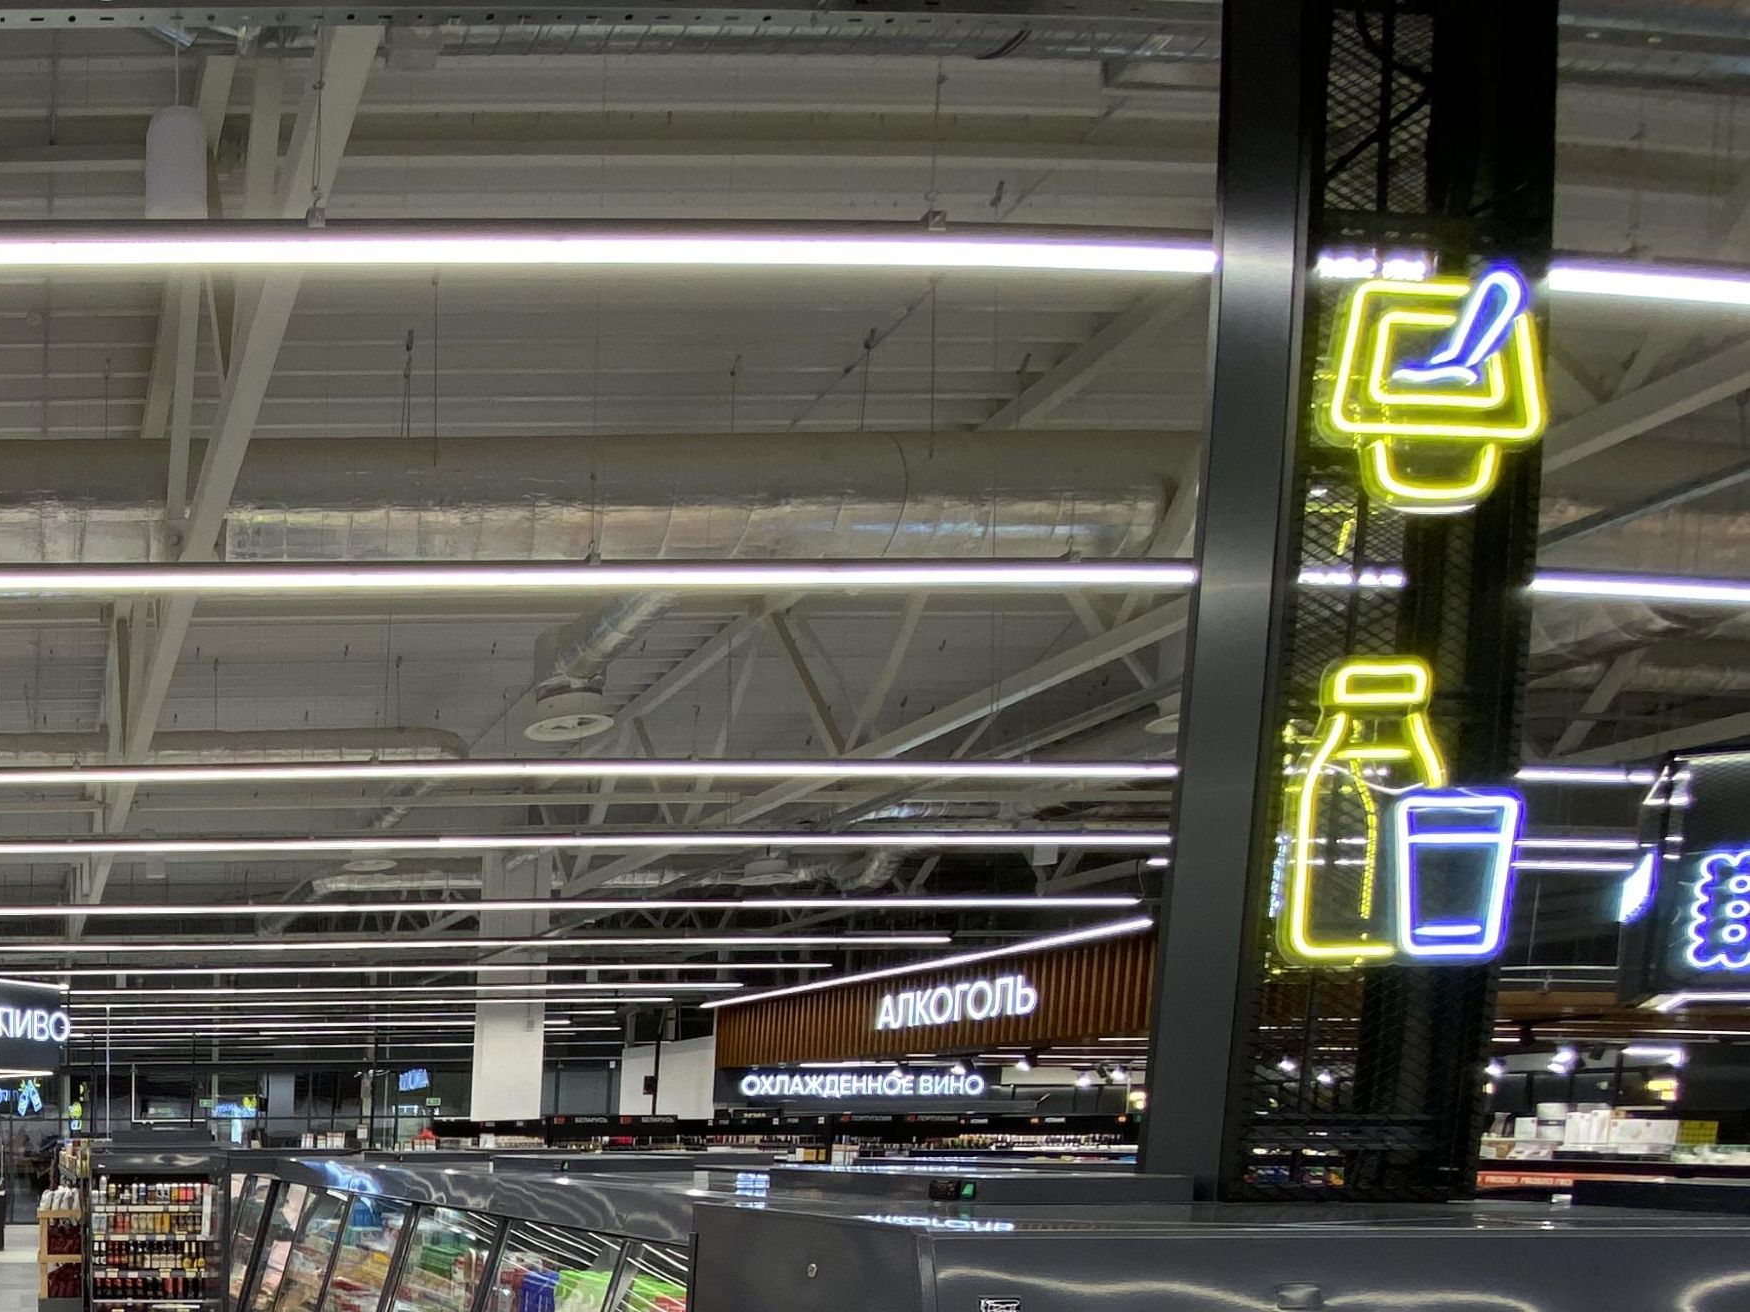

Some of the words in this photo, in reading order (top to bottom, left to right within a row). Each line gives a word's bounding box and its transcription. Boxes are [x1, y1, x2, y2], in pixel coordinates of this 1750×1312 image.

[876, 976, 1037, 1030] АЛКОГОЛЬ
[740, 1073, 914, 1099] ОХЛАЖДЕННОЕ
[919, 1074, 985, 1096] ВИНО
